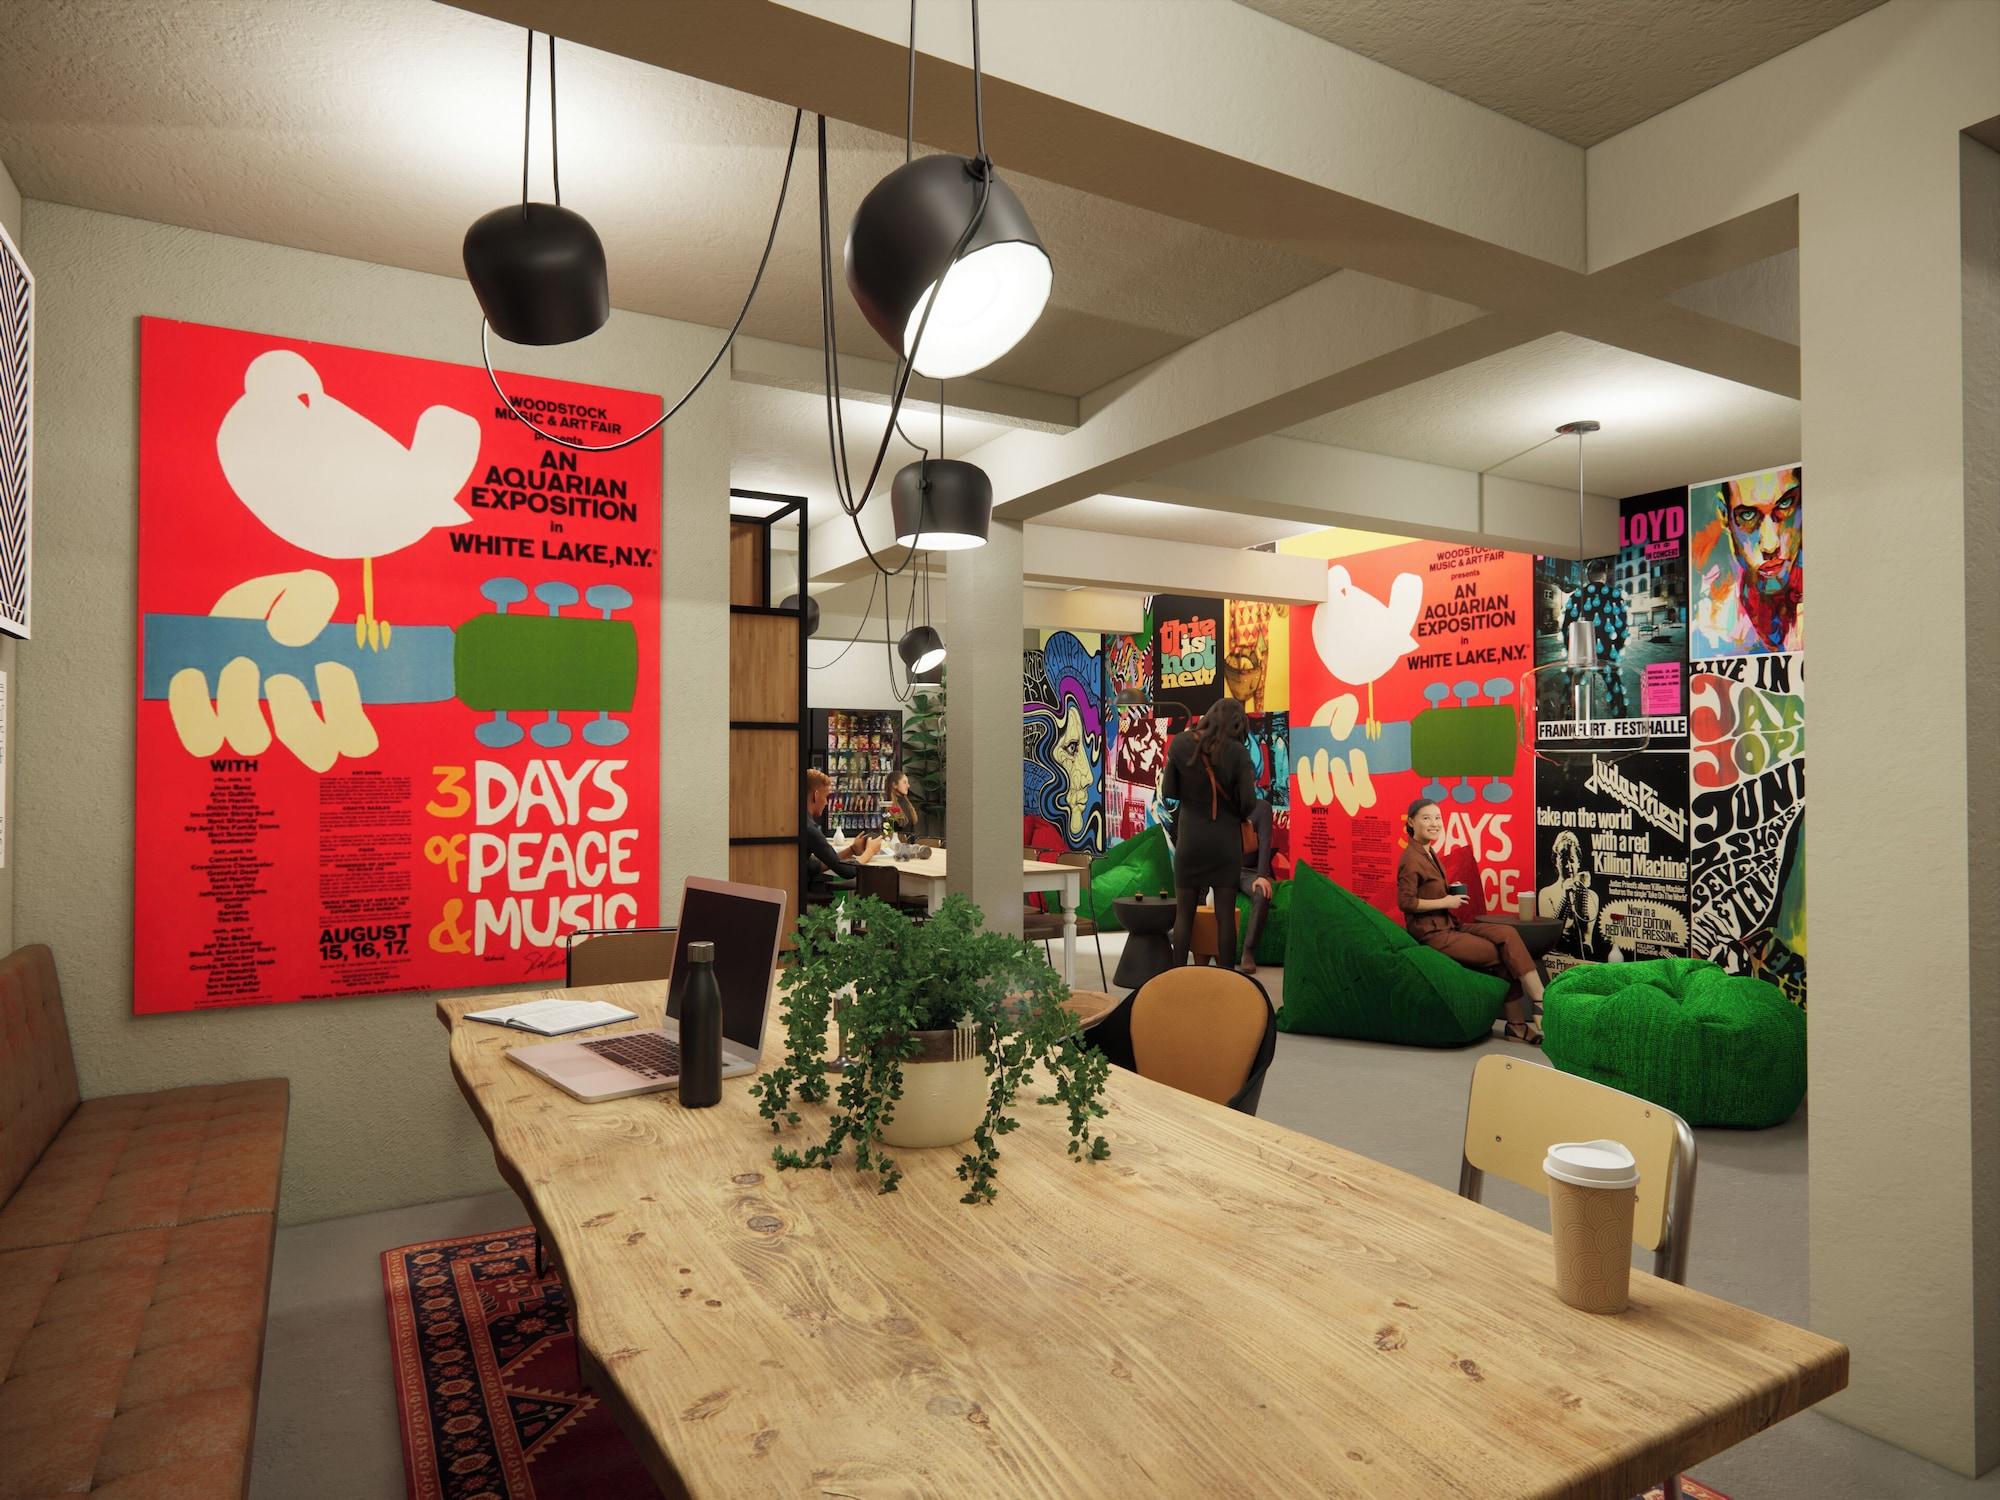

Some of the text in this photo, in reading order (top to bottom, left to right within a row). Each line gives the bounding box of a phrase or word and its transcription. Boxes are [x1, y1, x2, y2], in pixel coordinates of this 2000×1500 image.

[509, 396, 607, 420] WOODSTOCK
[495, 408, 621, 435] MUSIC & ART FAIR
[540, 450, 577, 472] AN
[484, 466, 627, 500] AQUARIAN
[471, 487, 637, 522] EXPOSITION
[550, 520, 563, 533] in
[449, 532, 535, 559] WHITE
[1430, 560, 1456, 572] MUSIC
[1466, 554, 1482, 566] ART
[1484, 550, 1504, 562] FAIR
[1451, 570, 1480, 580] presents
[1454, 582, 1476, 600] AN
[1424, 594, 1508, 620] AQUARIAN
[1418, 610, 1516, 637] EXPOSITION
[1461, 636, 1468, 645] in
[1161, 635, 1216, 676] not
[1408, 653, 1452, 670] WHITE
[1161, 666, 1216, 689] new
[1689, 658, 1747, 682] LIVE
[1755, 654, 1792, 694] IN
[210, 760, 258, 772] WITH
[425, 766, 472, 818] 3
[474, 760, 629, 828] DAYS
[1584, 753, 1688, 843] Judas Priest
[1311, 807, 1328, 816] WITH
[1537, 806, 1632, 830] take on the world
[1591, 830, 1650, 854] with a red
[424, 834, 466, 883] of
[468, 828, 640, 893] PEACE
[1692, 849, 1777, 914] SEVEN
[1628, 904, 1656, 917] Now in a
[1721, 870, 1774, 936] TEN
[320, 923, 412, 944] AUGUST
[428, 892, 638, 956] & MUSIC
[1606, 924, 1619, 936] RED
[1620, 926, 1640, 938] VINYL
[1643, 918, 1672, 930] EDITION
[320, 940, 408, 962] 15, 16, 17.
